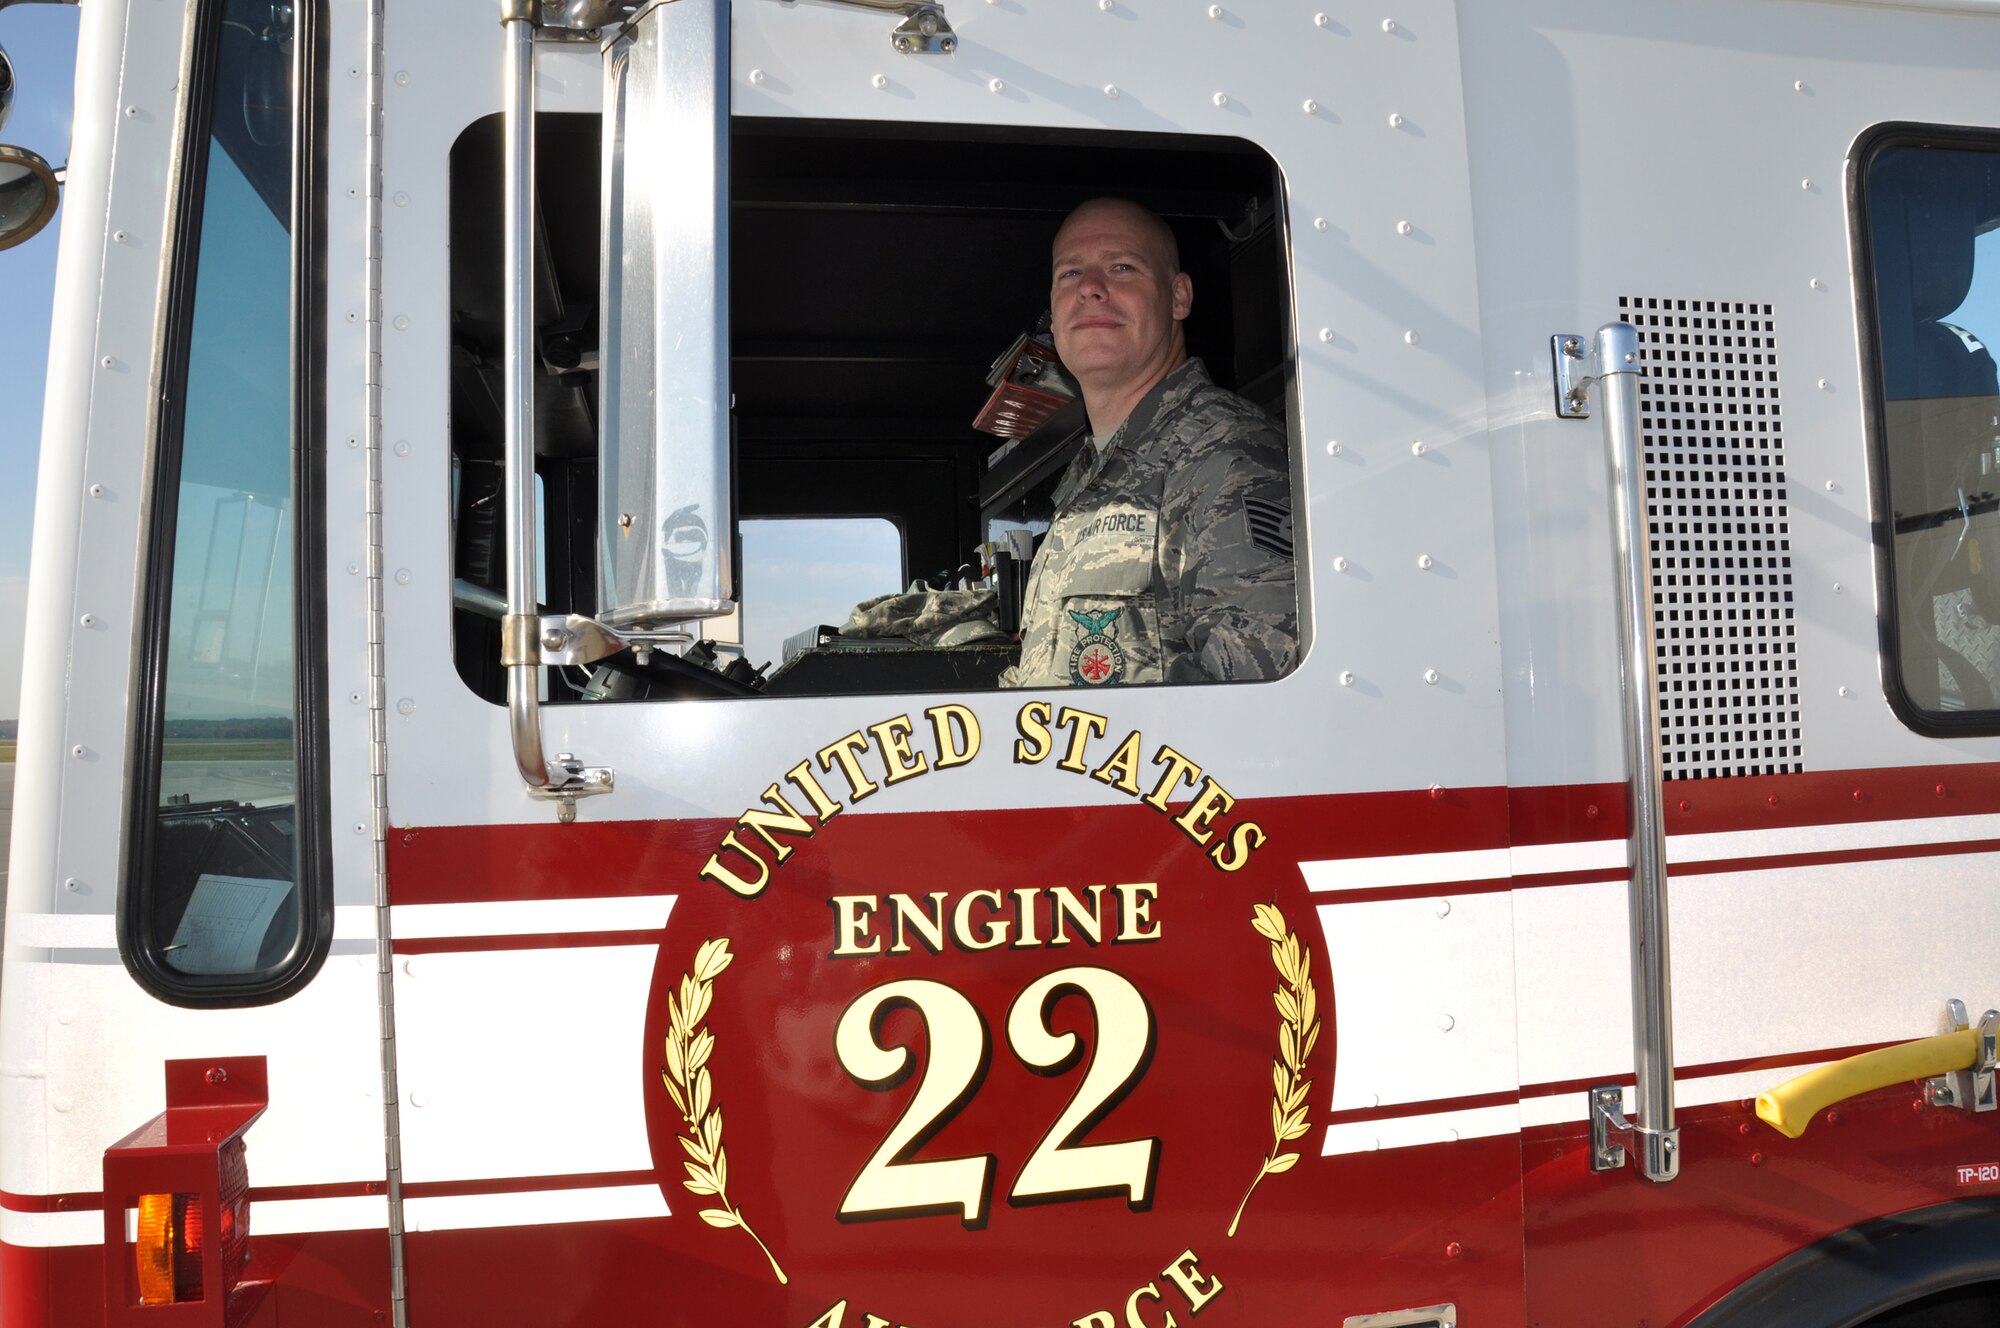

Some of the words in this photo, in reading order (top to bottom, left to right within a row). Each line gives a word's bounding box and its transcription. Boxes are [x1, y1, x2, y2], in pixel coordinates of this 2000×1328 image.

[1101, 513, 1147, 533] FORCE
[1070, 647, 1082, 674] FIRE
[1081, 634, 1122, 673] PROTECTION
[699, 703, 982, 900] UNITED
[1013, 701, 1268, 873] STATES
[829, 882, 1162, 957] ENGINE
[833, 964, 1161, 1231] 22
[1957, 1165, 1999, 1184] TP-120
